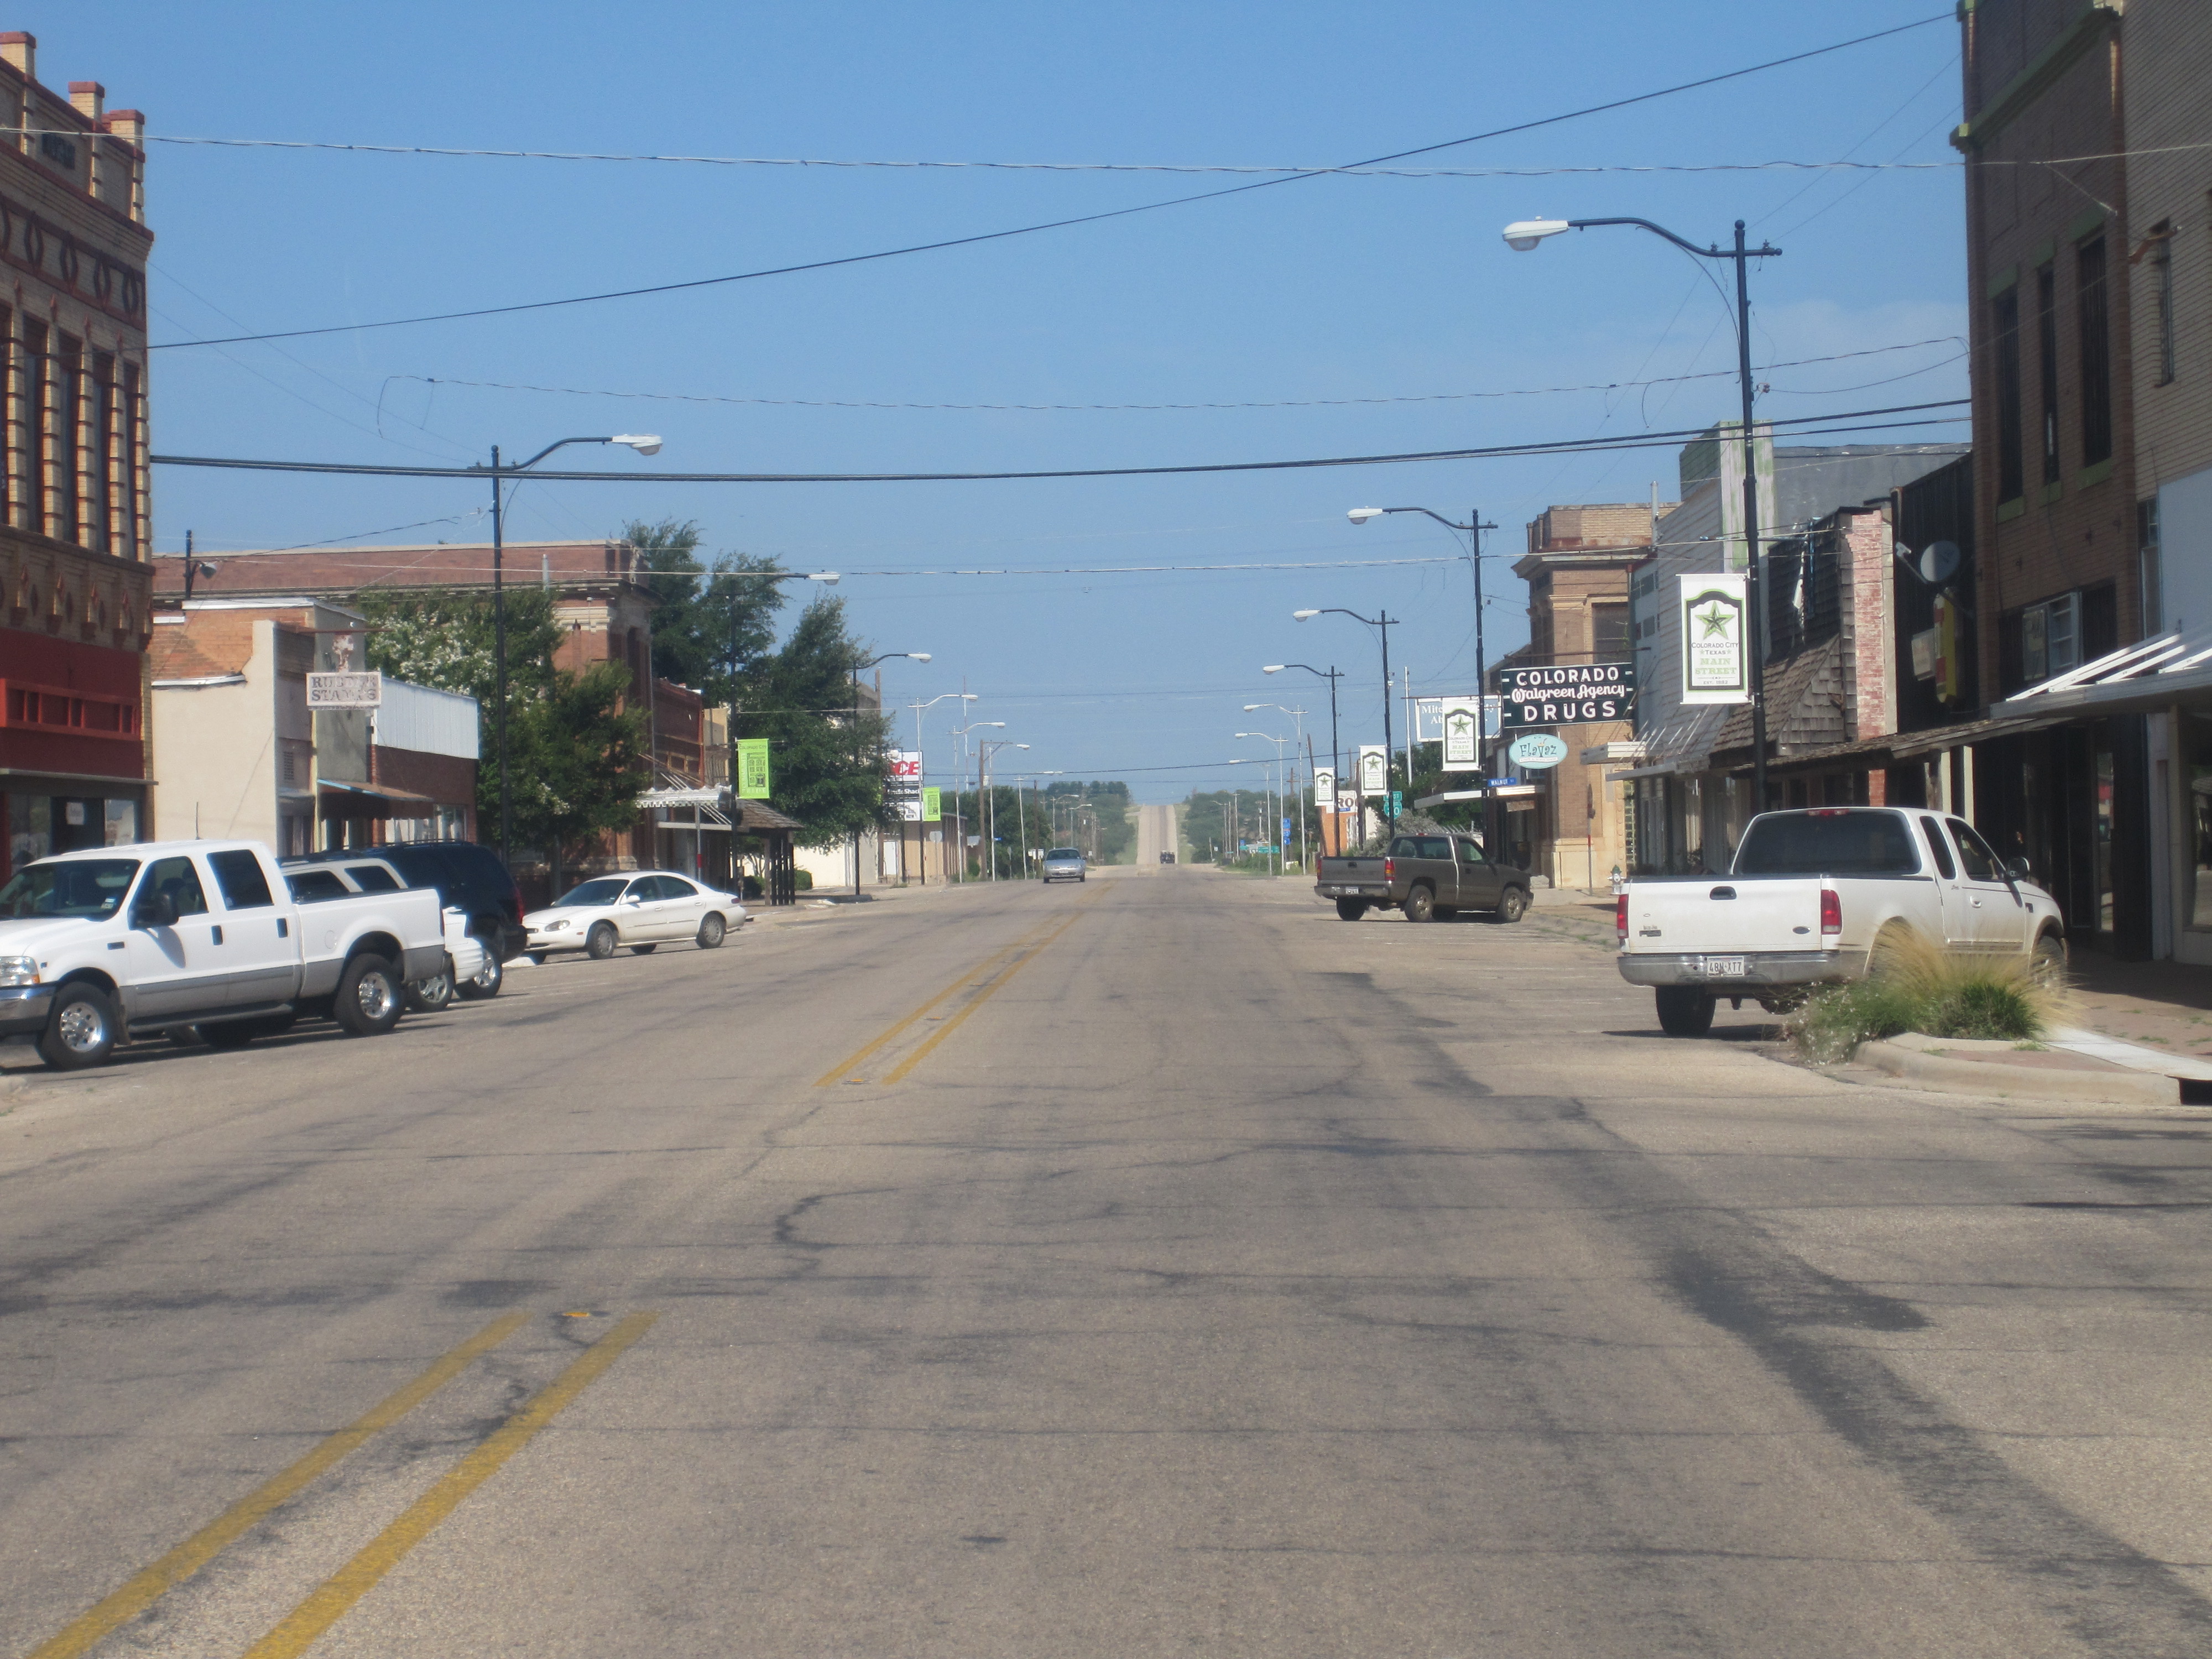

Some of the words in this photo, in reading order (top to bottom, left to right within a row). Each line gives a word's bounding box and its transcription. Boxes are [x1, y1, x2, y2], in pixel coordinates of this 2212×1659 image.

[1516, 666, 1619, 686] COLORADO
[1511, 686, 1575, 703] Walgreen
[1576, 684, 1625, 699] Agency
[1524, 701, 1616, 722] DRUGS
[1519, 743, 1557, 758] Flavaz
